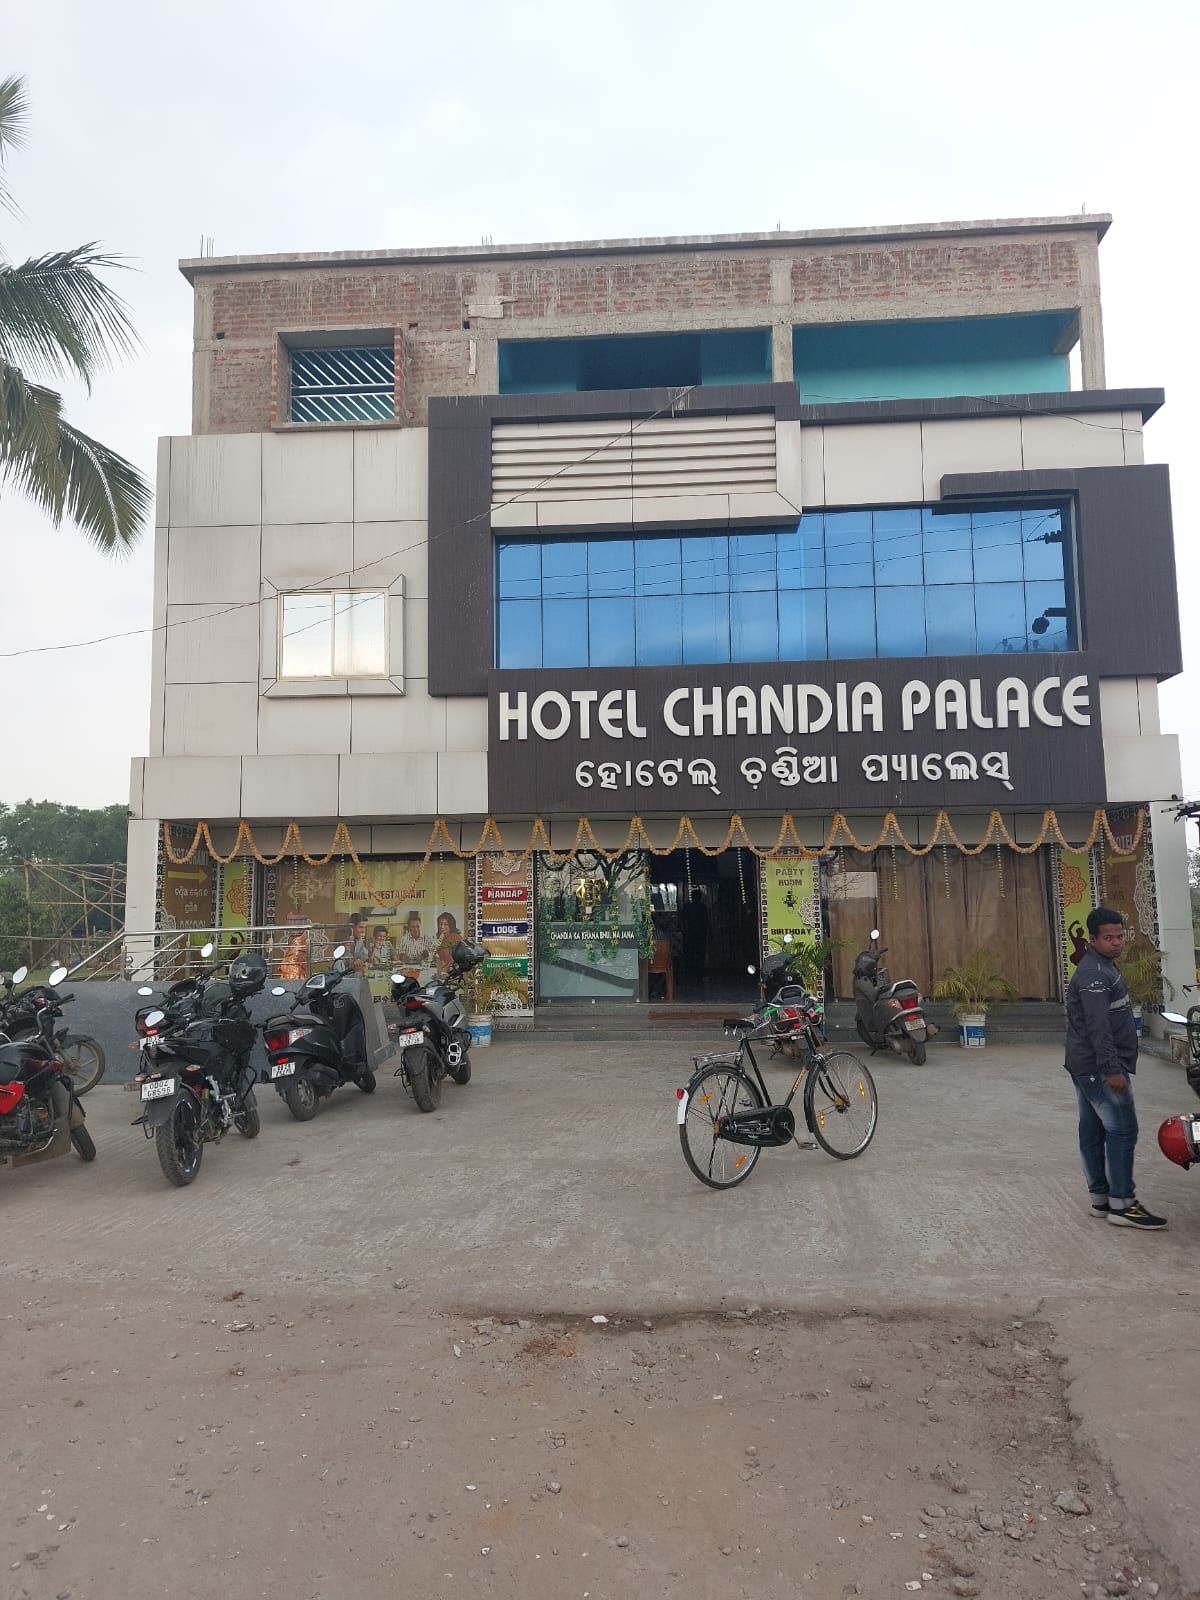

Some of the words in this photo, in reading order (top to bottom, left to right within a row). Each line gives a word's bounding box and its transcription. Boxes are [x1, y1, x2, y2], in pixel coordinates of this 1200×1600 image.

[499, 689, 647, 741] HOTEL
[663, 681, 884, 737] CHANDIA
[902, 675, 1091, 731] PALACE
[575, 757, 721, 796] ହୋଟେଲ୍
[861, 751, 1014, 791] ପ୍ୟାଲେସ୍
[775, 868, 805, 876] PARTY
[344, 877, 356, 887] AC
[487, 889, 523, 898] MANDAP
[492, 925, 519, 934] LODGE
